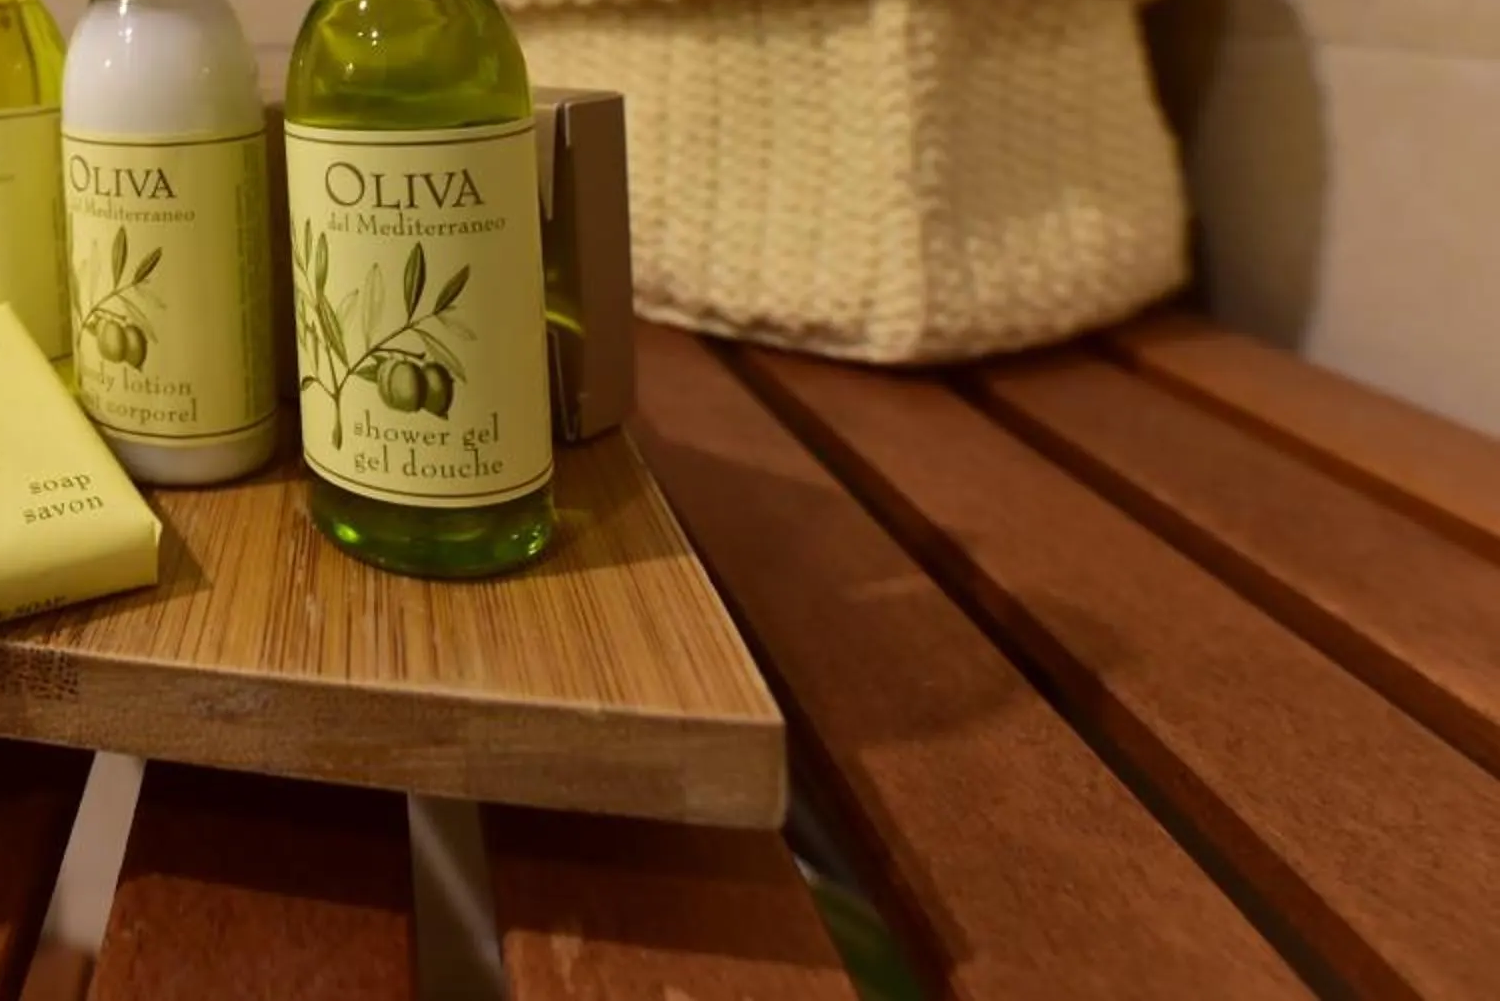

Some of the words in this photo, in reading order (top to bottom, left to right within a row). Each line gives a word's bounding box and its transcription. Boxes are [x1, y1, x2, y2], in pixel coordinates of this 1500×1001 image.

[69, 154, 177, 199] OLIVA
[325, 161, 485, 210] OLIVA
[328, 212, 349, 232] del
[357, 212, 506, 237] Mediterraneo
[123, 366, 192, 396] lotion
[106, 398, 198, 426] corporel
[354, 409, 450, 446] shower
[462, 411, 499, 452] gel
[354, 444, 389, 474] gel
[402, 448, 504, 479] douche
[28, 474, 91, 495] soap
[23, 495, 104, 525] savon
